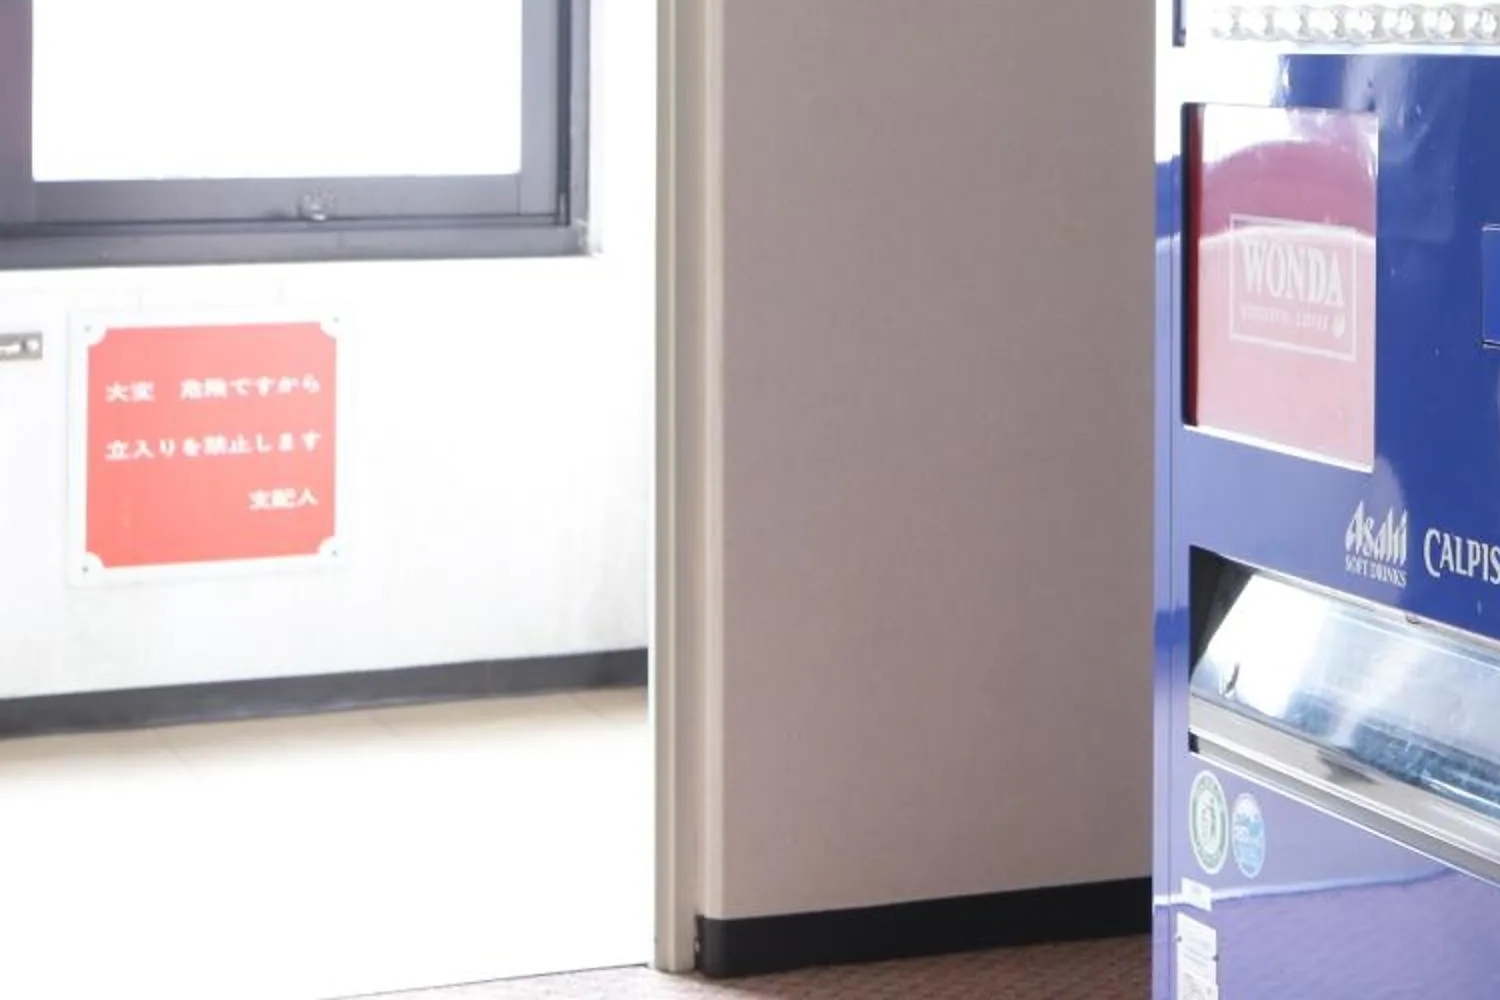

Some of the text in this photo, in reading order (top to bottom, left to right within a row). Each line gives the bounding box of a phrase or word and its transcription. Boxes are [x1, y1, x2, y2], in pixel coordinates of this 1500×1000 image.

[1241, 239, 1344, 307] WONDA
[105, 374, 321, 403] 大変 危険ですから
[104, 429, 321, 462] 立入りを禁止します
[249, 487, 318, 511] 支配人
[1345, 501, 1408, 567] Asahi
[1345, 553, 1408, 588] SOFT DRINKS
